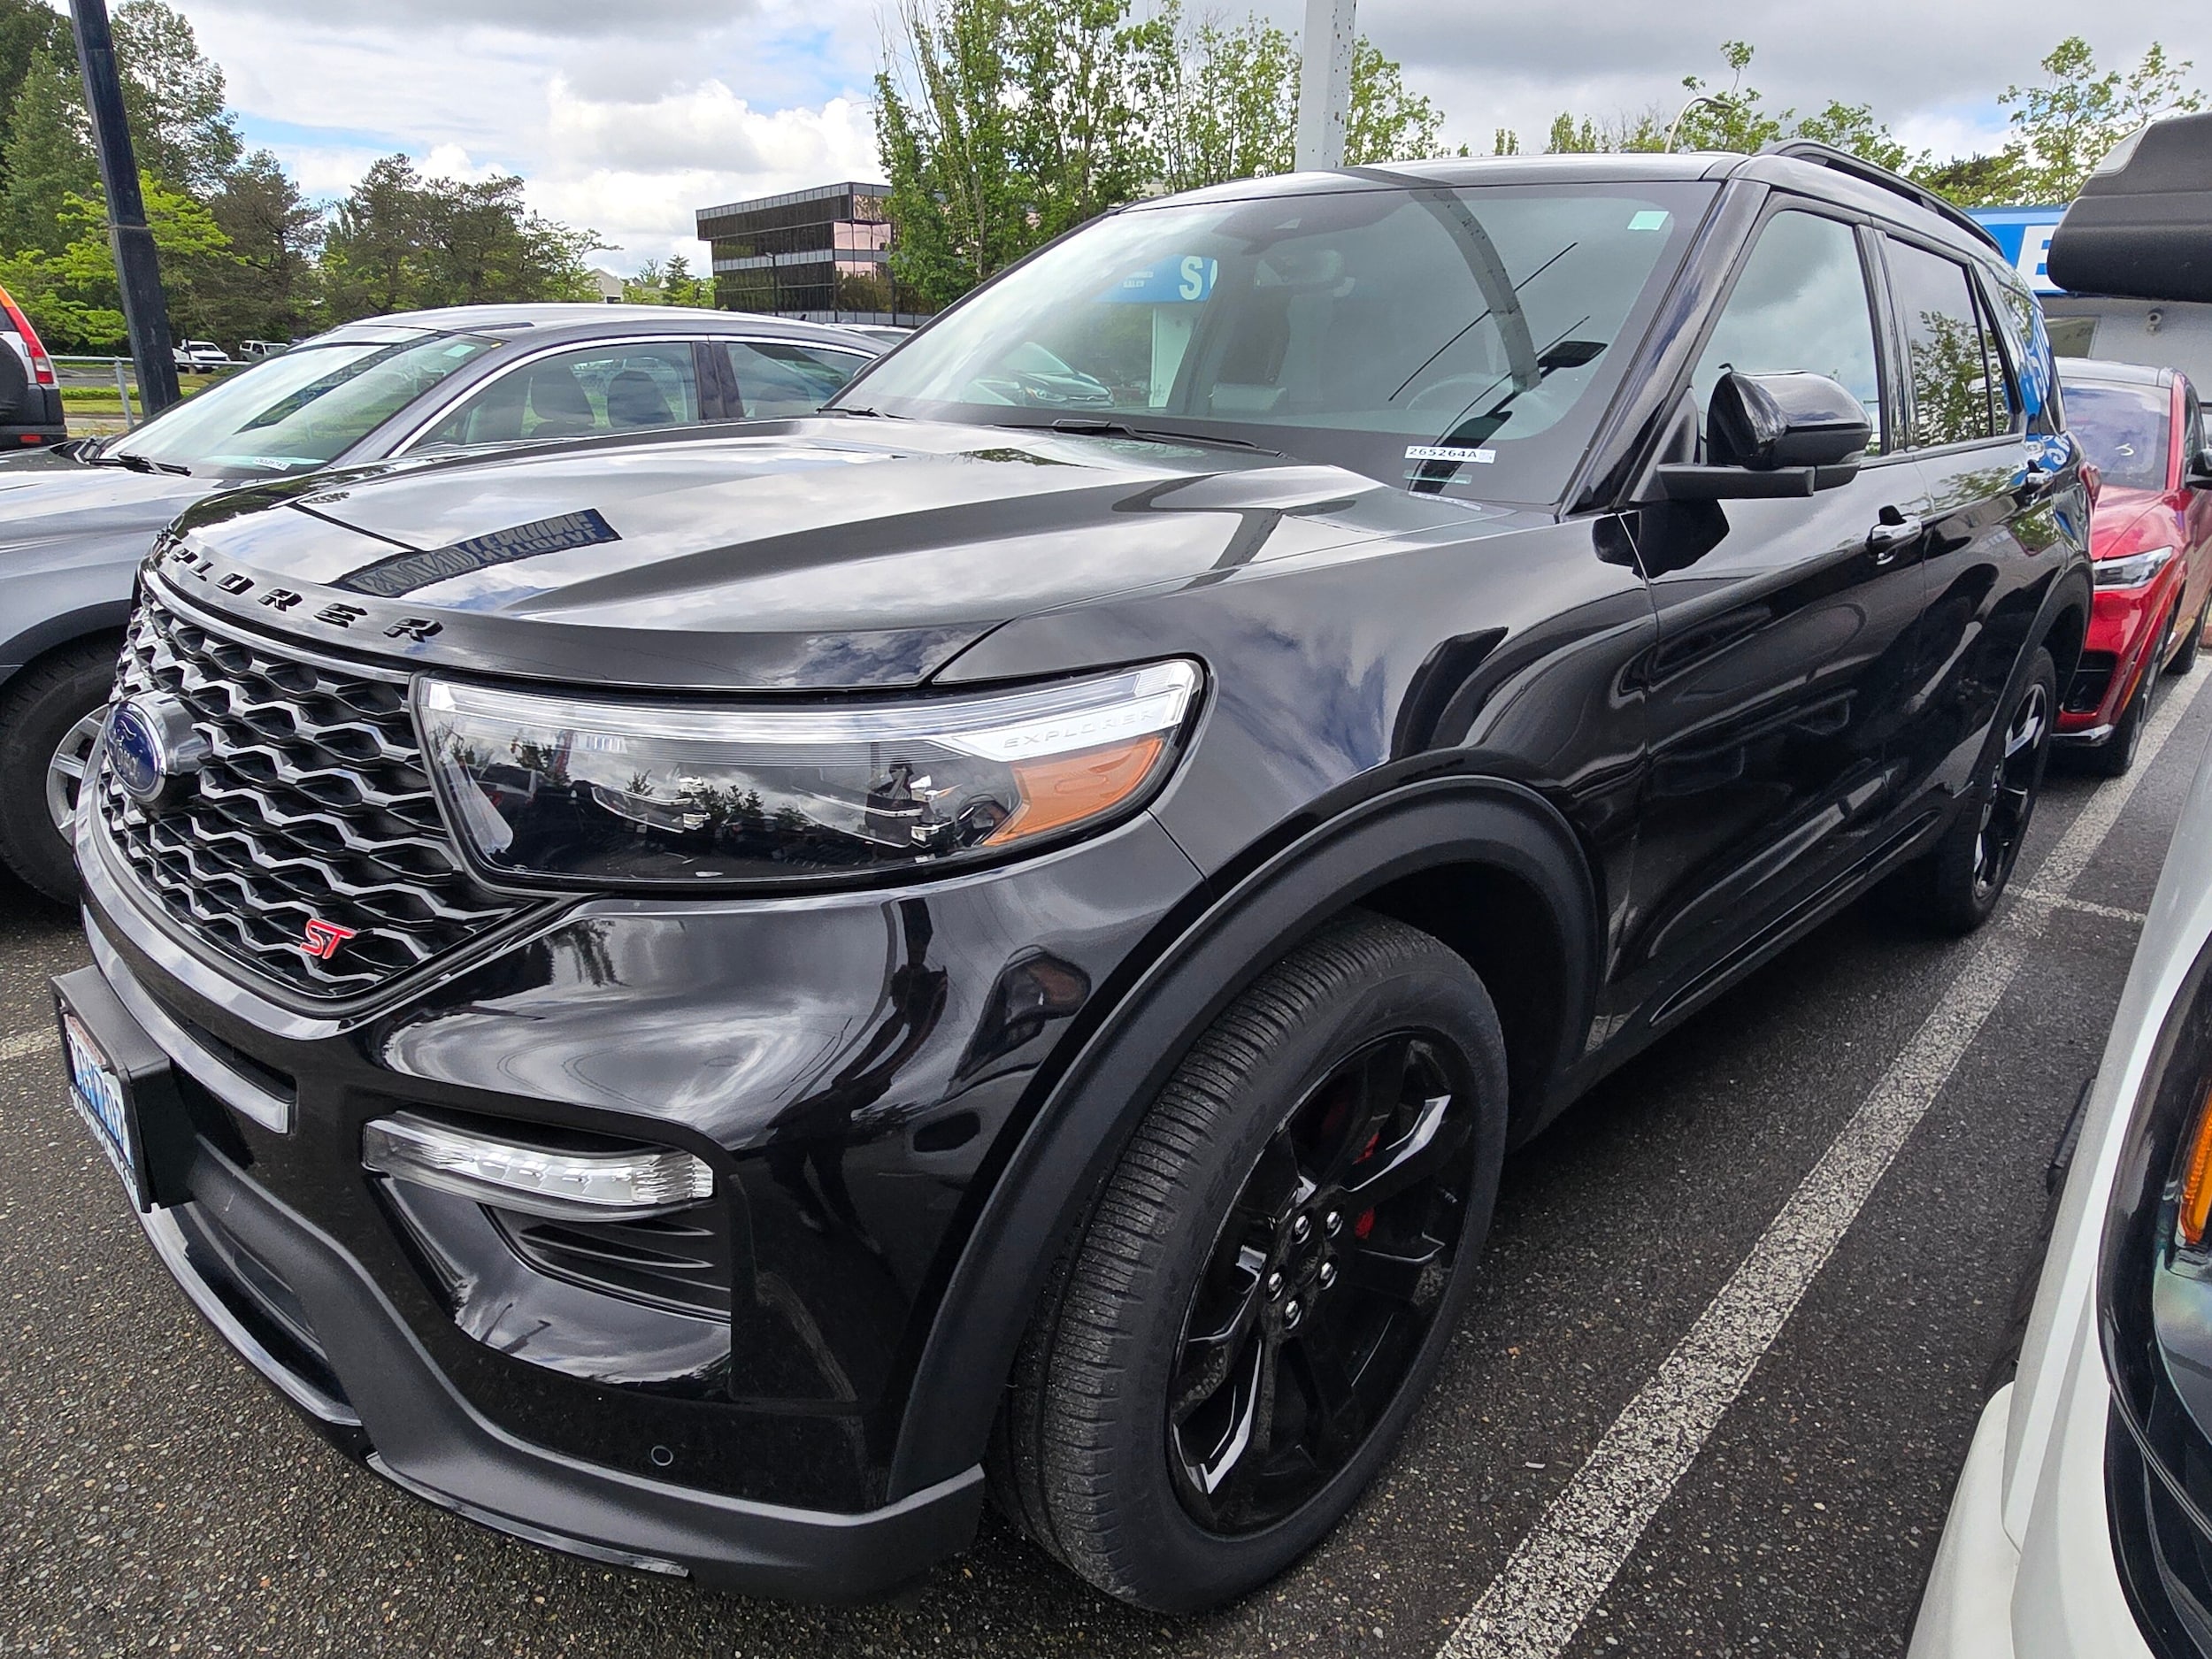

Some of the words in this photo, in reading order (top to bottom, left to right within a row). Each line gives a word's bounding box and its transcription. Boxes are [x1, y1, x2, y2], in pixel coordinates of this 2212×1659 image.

[1409, 448, 1477, 458] 265264A
[157, 529, 444, 642] PLORER
[1003, 709, 1155, 749] EXPLORER
[300, 918, 357, 960] ST
